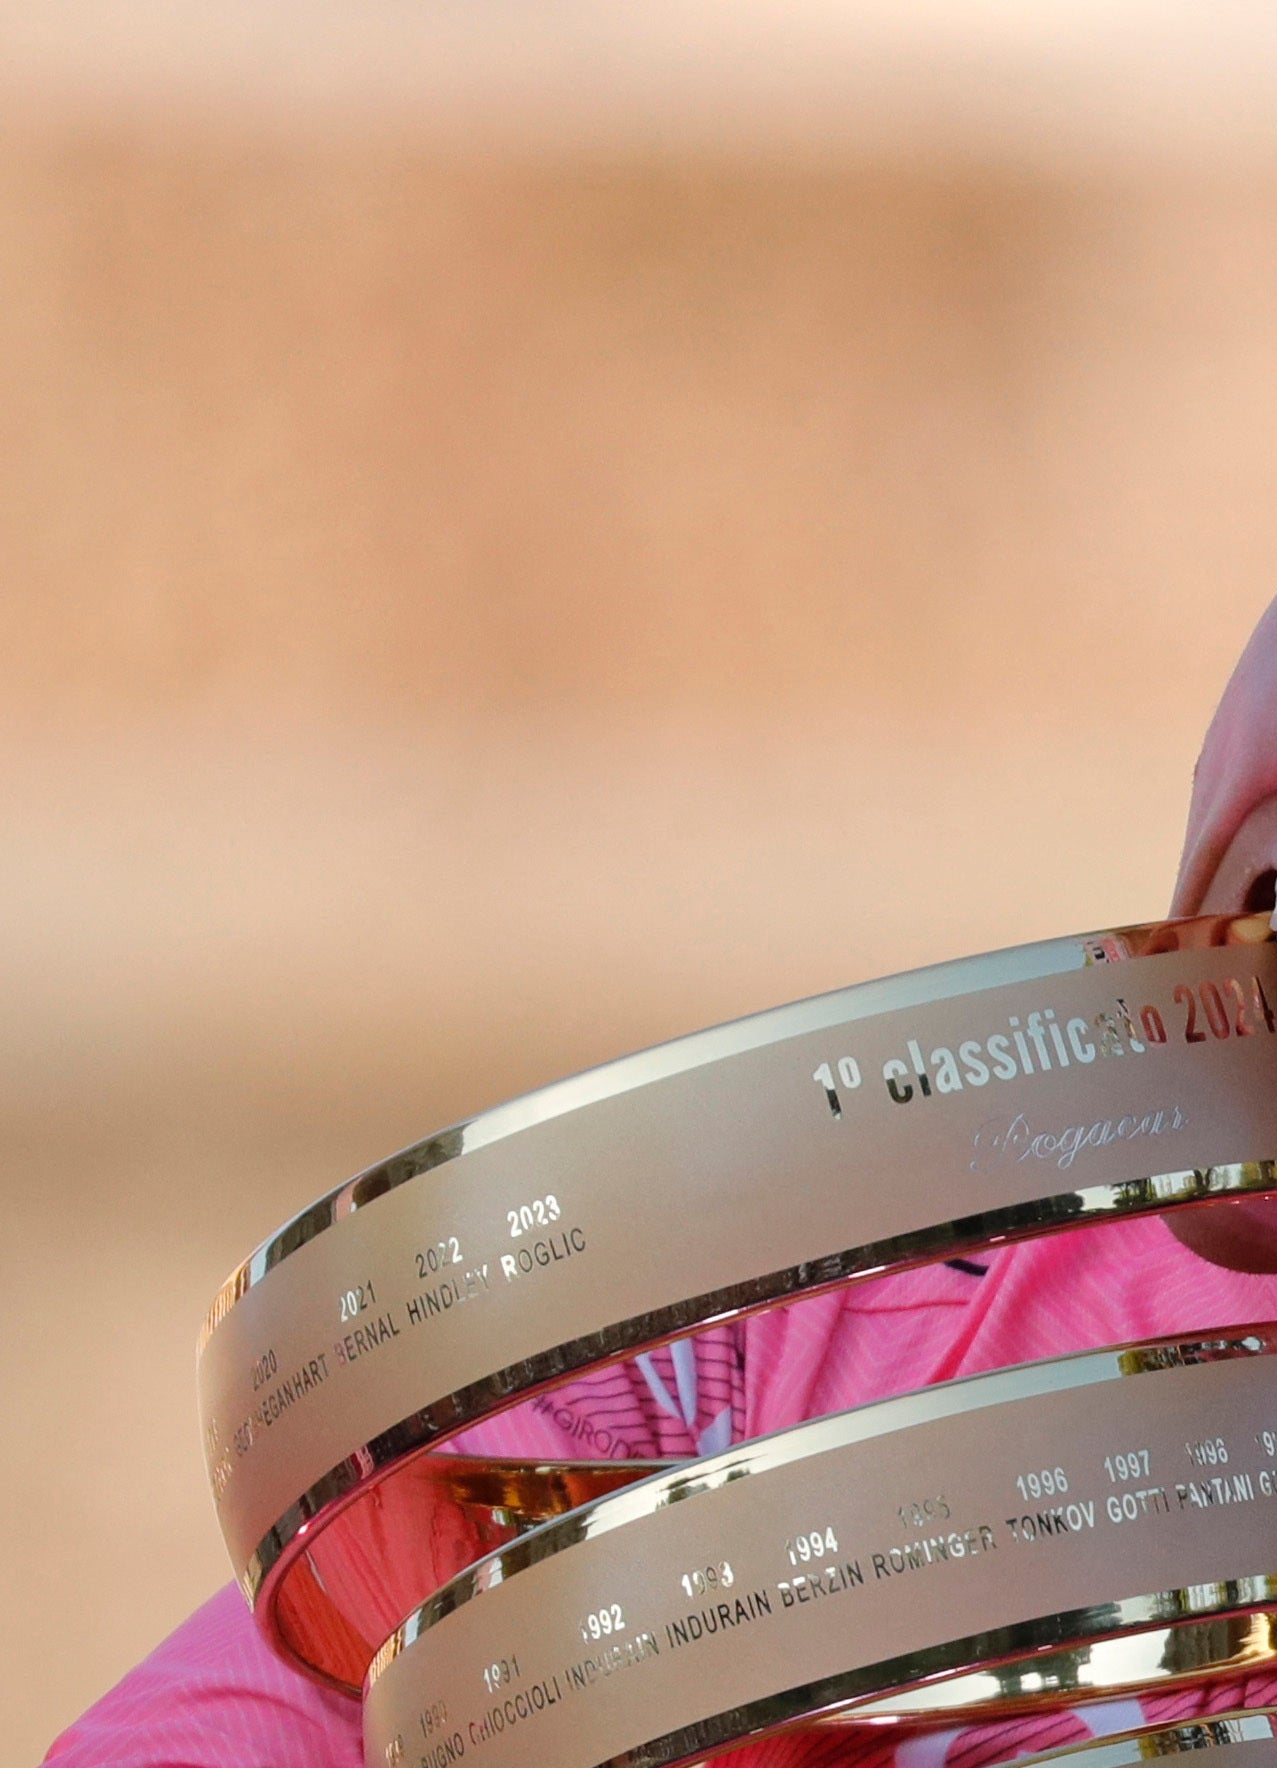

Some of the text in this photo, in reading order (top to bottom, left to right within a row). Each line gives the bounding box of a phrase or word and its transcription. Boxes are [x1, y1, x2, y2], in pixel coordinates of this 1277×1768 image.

[881, 999, 1168, 1105] classificato
[1172, 975, 1276, 1045] 2024
[340, 1280, 377, 1323] 2021
[415, 1237, 464, 1280] 2022
[507, 1194, 562, 1239] 2023
[405, 1264, 492, 1327] HINDLEY
[500, 1227, 587, 1284] ROGLIC
[665, 1589, 772, 1649] INDURAIN
[777, 1560, 865, 1608] BERZIN
[1005, 1500, 1097, 1544] TONKOV
[1105, 1486, 1171, 1523] GOTTI
[785, 1526, 839, 1567] 1994
[1016, 1466, 1069, 1502] 1996
[1103, 1449, 1151, 1483] 1997
